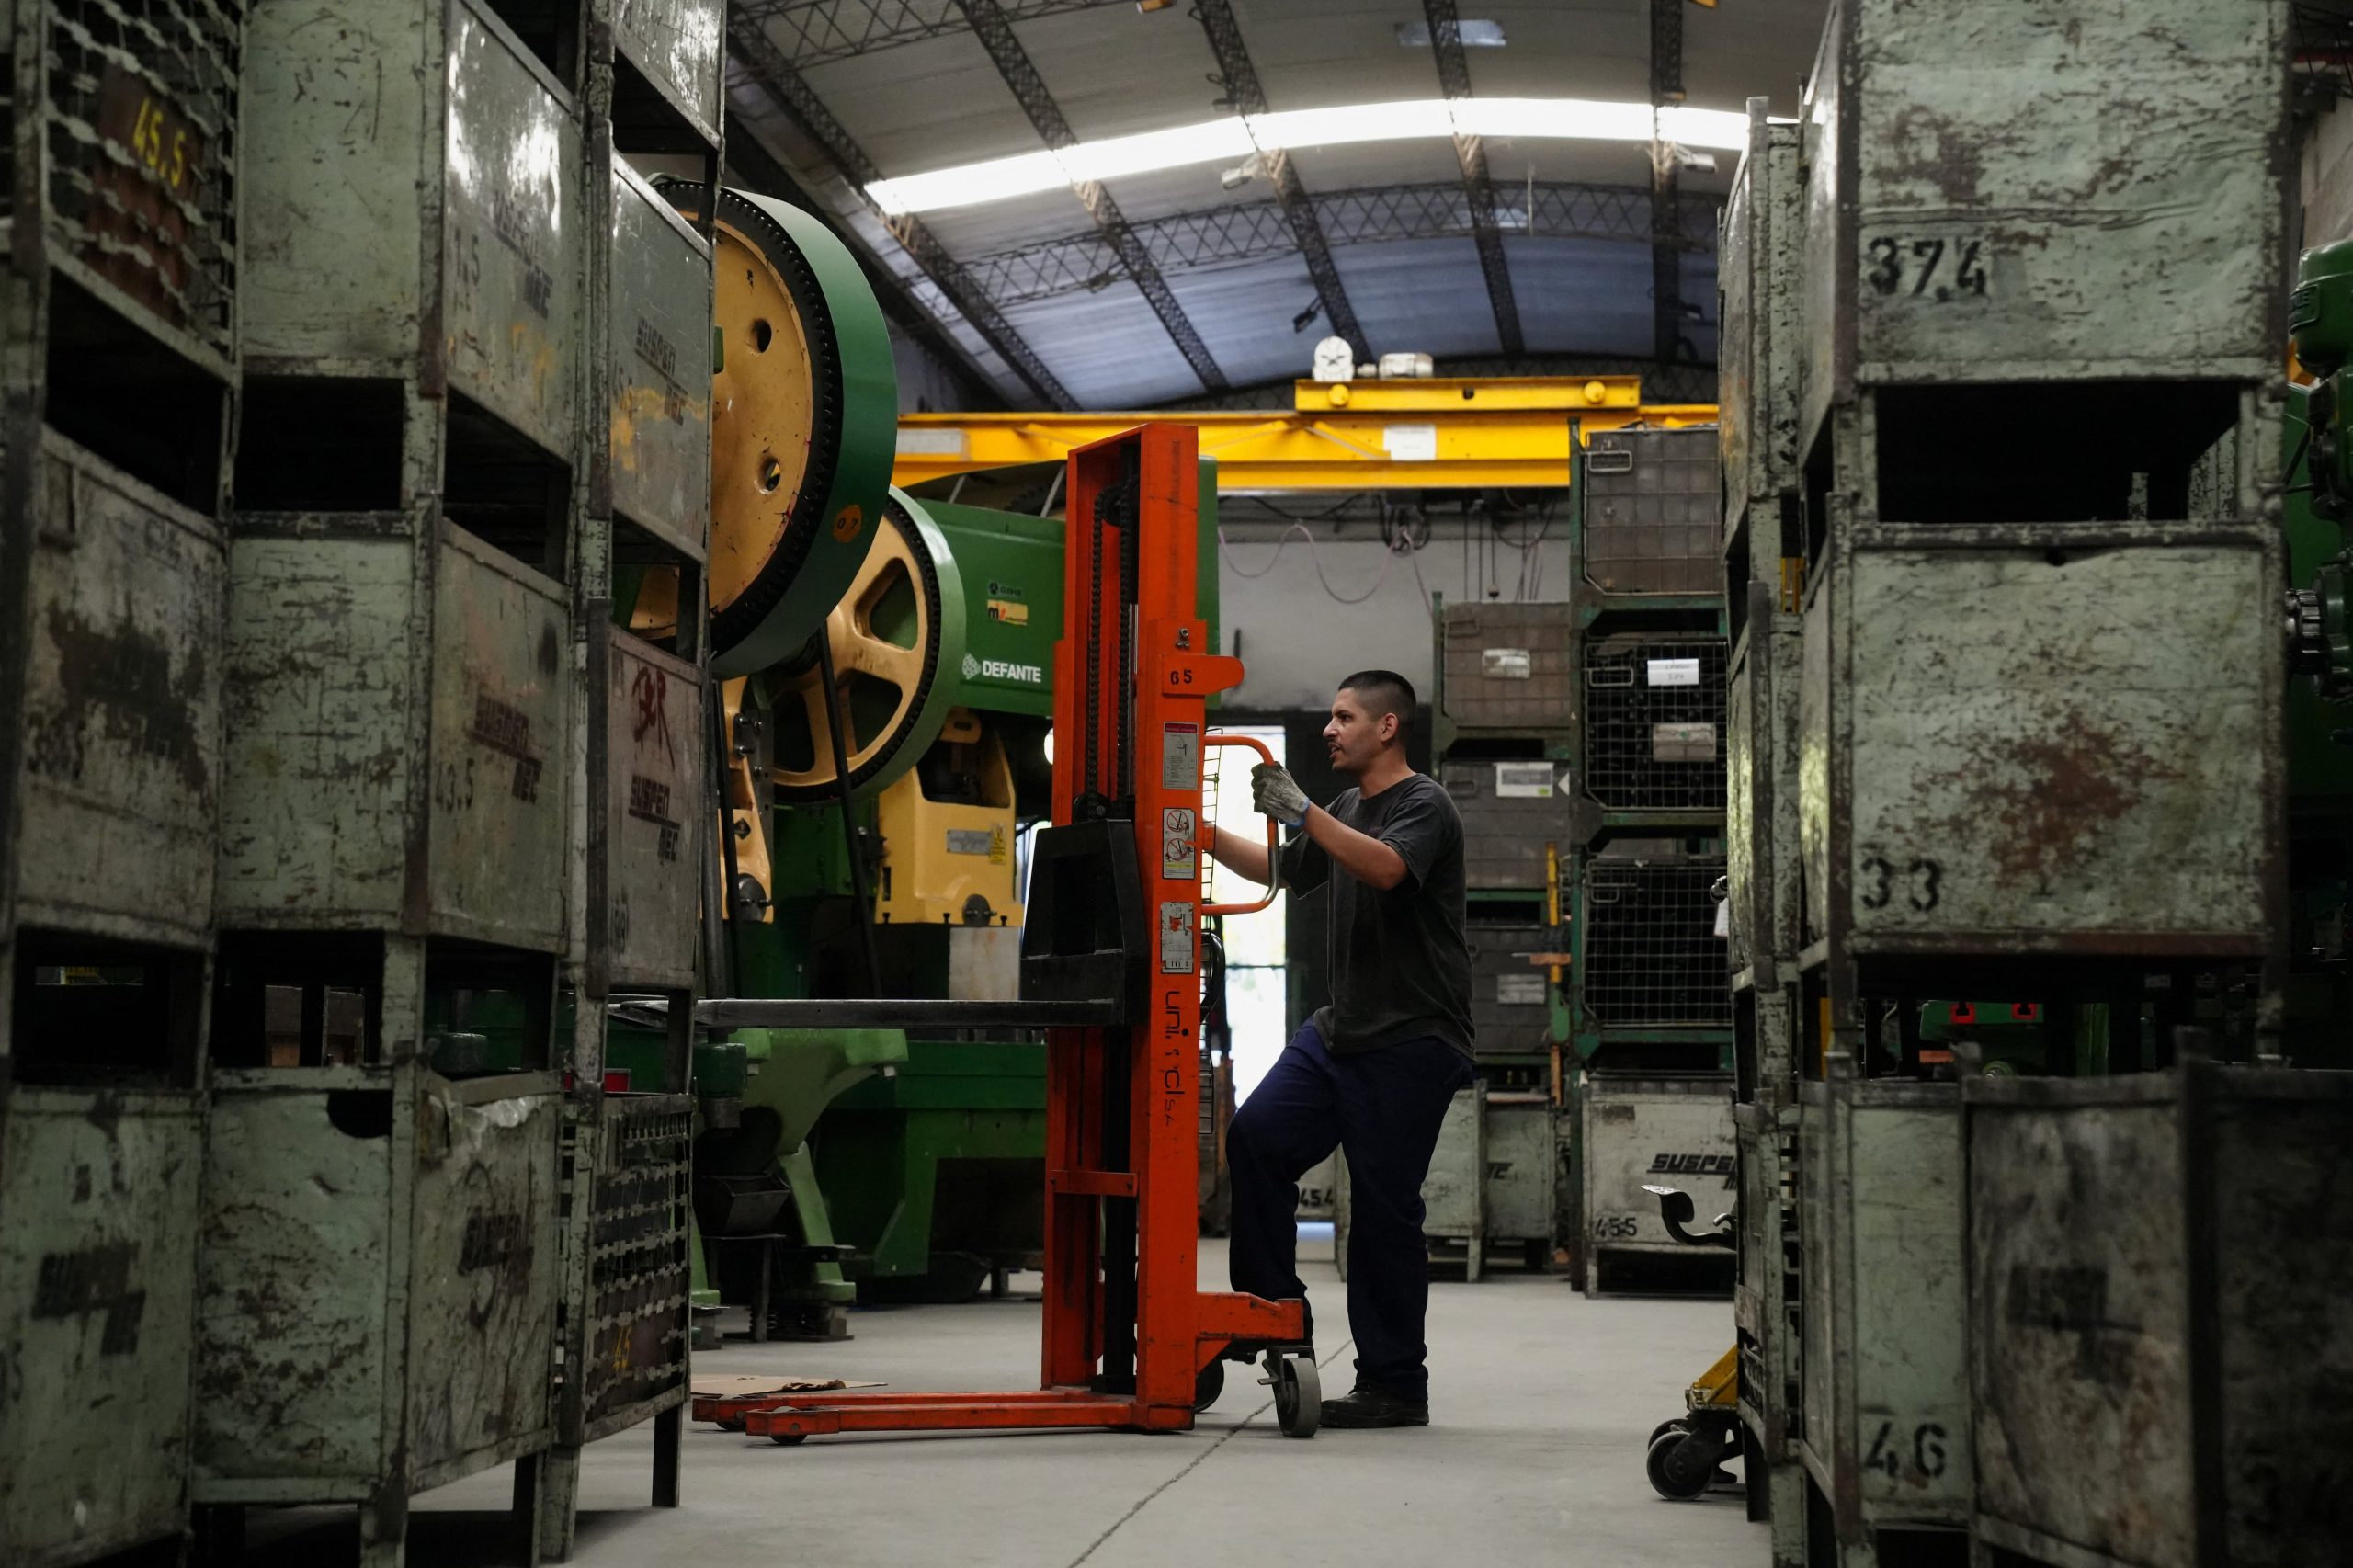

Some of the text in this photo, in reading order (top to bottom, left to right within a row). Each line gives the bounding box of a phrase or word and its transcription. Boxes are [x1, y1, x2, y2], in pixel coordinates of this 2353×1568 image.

[1870, 235, 1984, 300] 37.4
[983, 660, 1042, 683] DEFANTE
[1861, 857, 1941, 913] 33
[1864, 1422, 1946, 1479] 46
